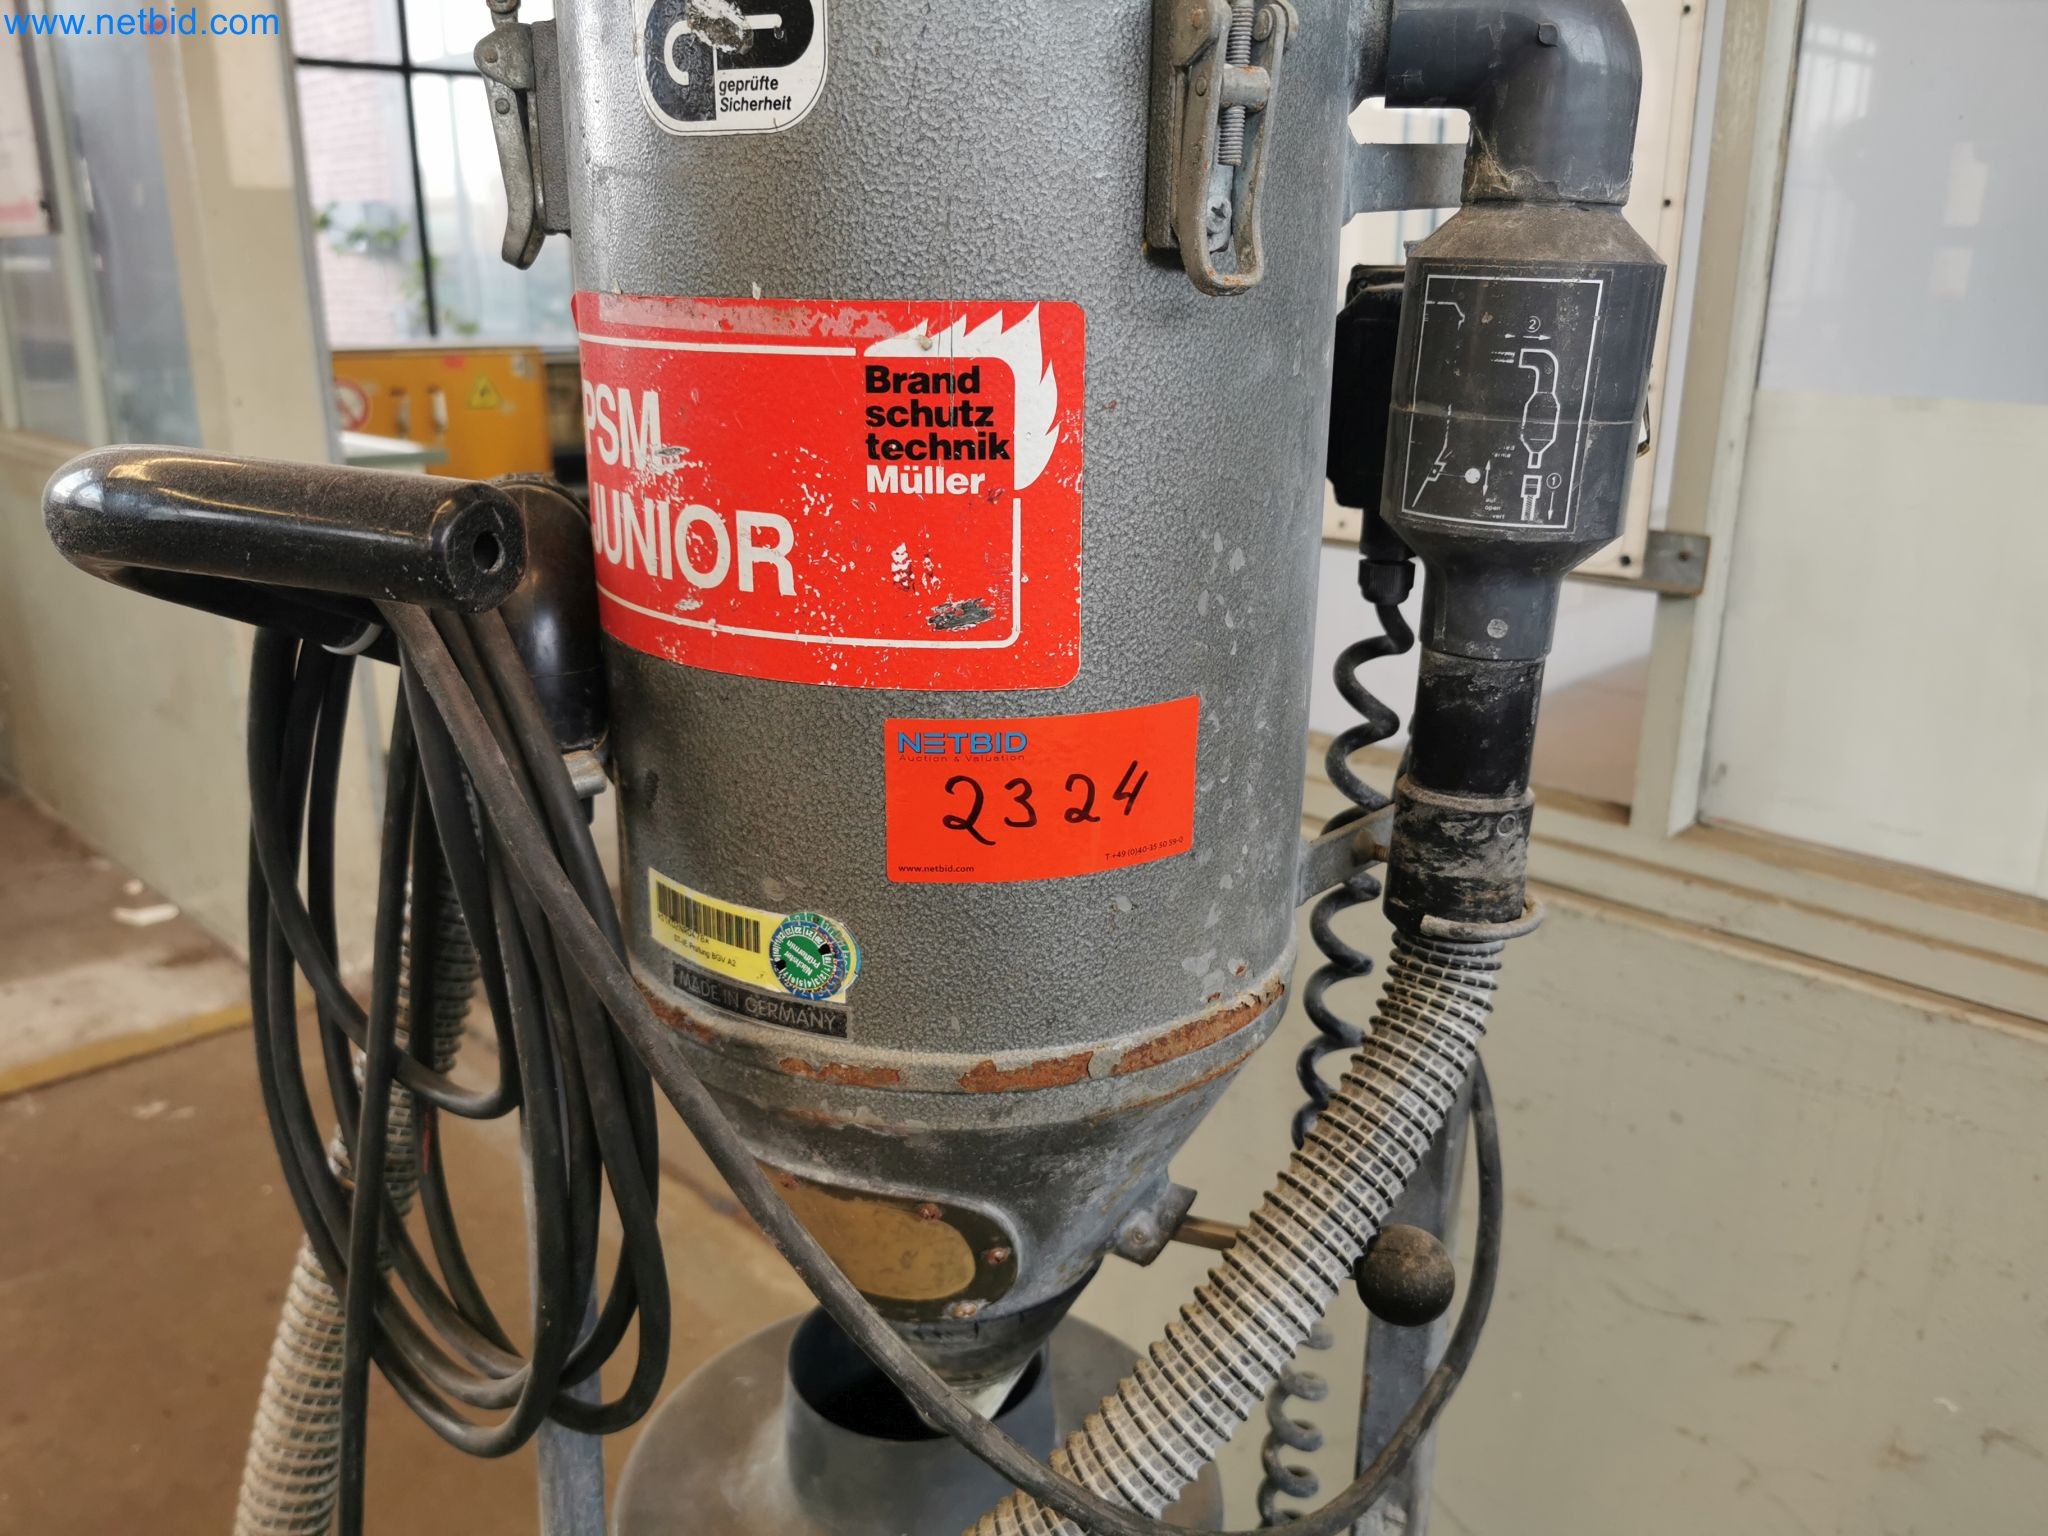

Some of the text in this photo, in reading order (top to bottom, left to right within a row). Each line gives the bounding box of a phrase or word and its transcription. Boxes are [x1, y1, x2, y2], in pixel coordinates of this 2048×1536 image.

[719, 75, 779, 96] geprüfte
[720, 96, 792, 113] Sicherheit
[865, 365, 980, 394] Brand
[583, 379, 663, 474] PSM
[865, 399, 994, 427] schutz
[865, 432, 1011, 460] technik
[866, 465, 985, 494] Müller
[591, 482, 797, 597] JUNIOR
[898, 732, 1027, 754] NETBID
[899, 754, 948, 763] Auction
[965, 754, 1025, 763] Valuation
[1112, 850, 1126, 858] +49
[1159, 841, 1167, 849] 50
[898, 864, 975, 873] www.netbid.com
[679, 970, 836, 1031] MADE IN GERMANY
